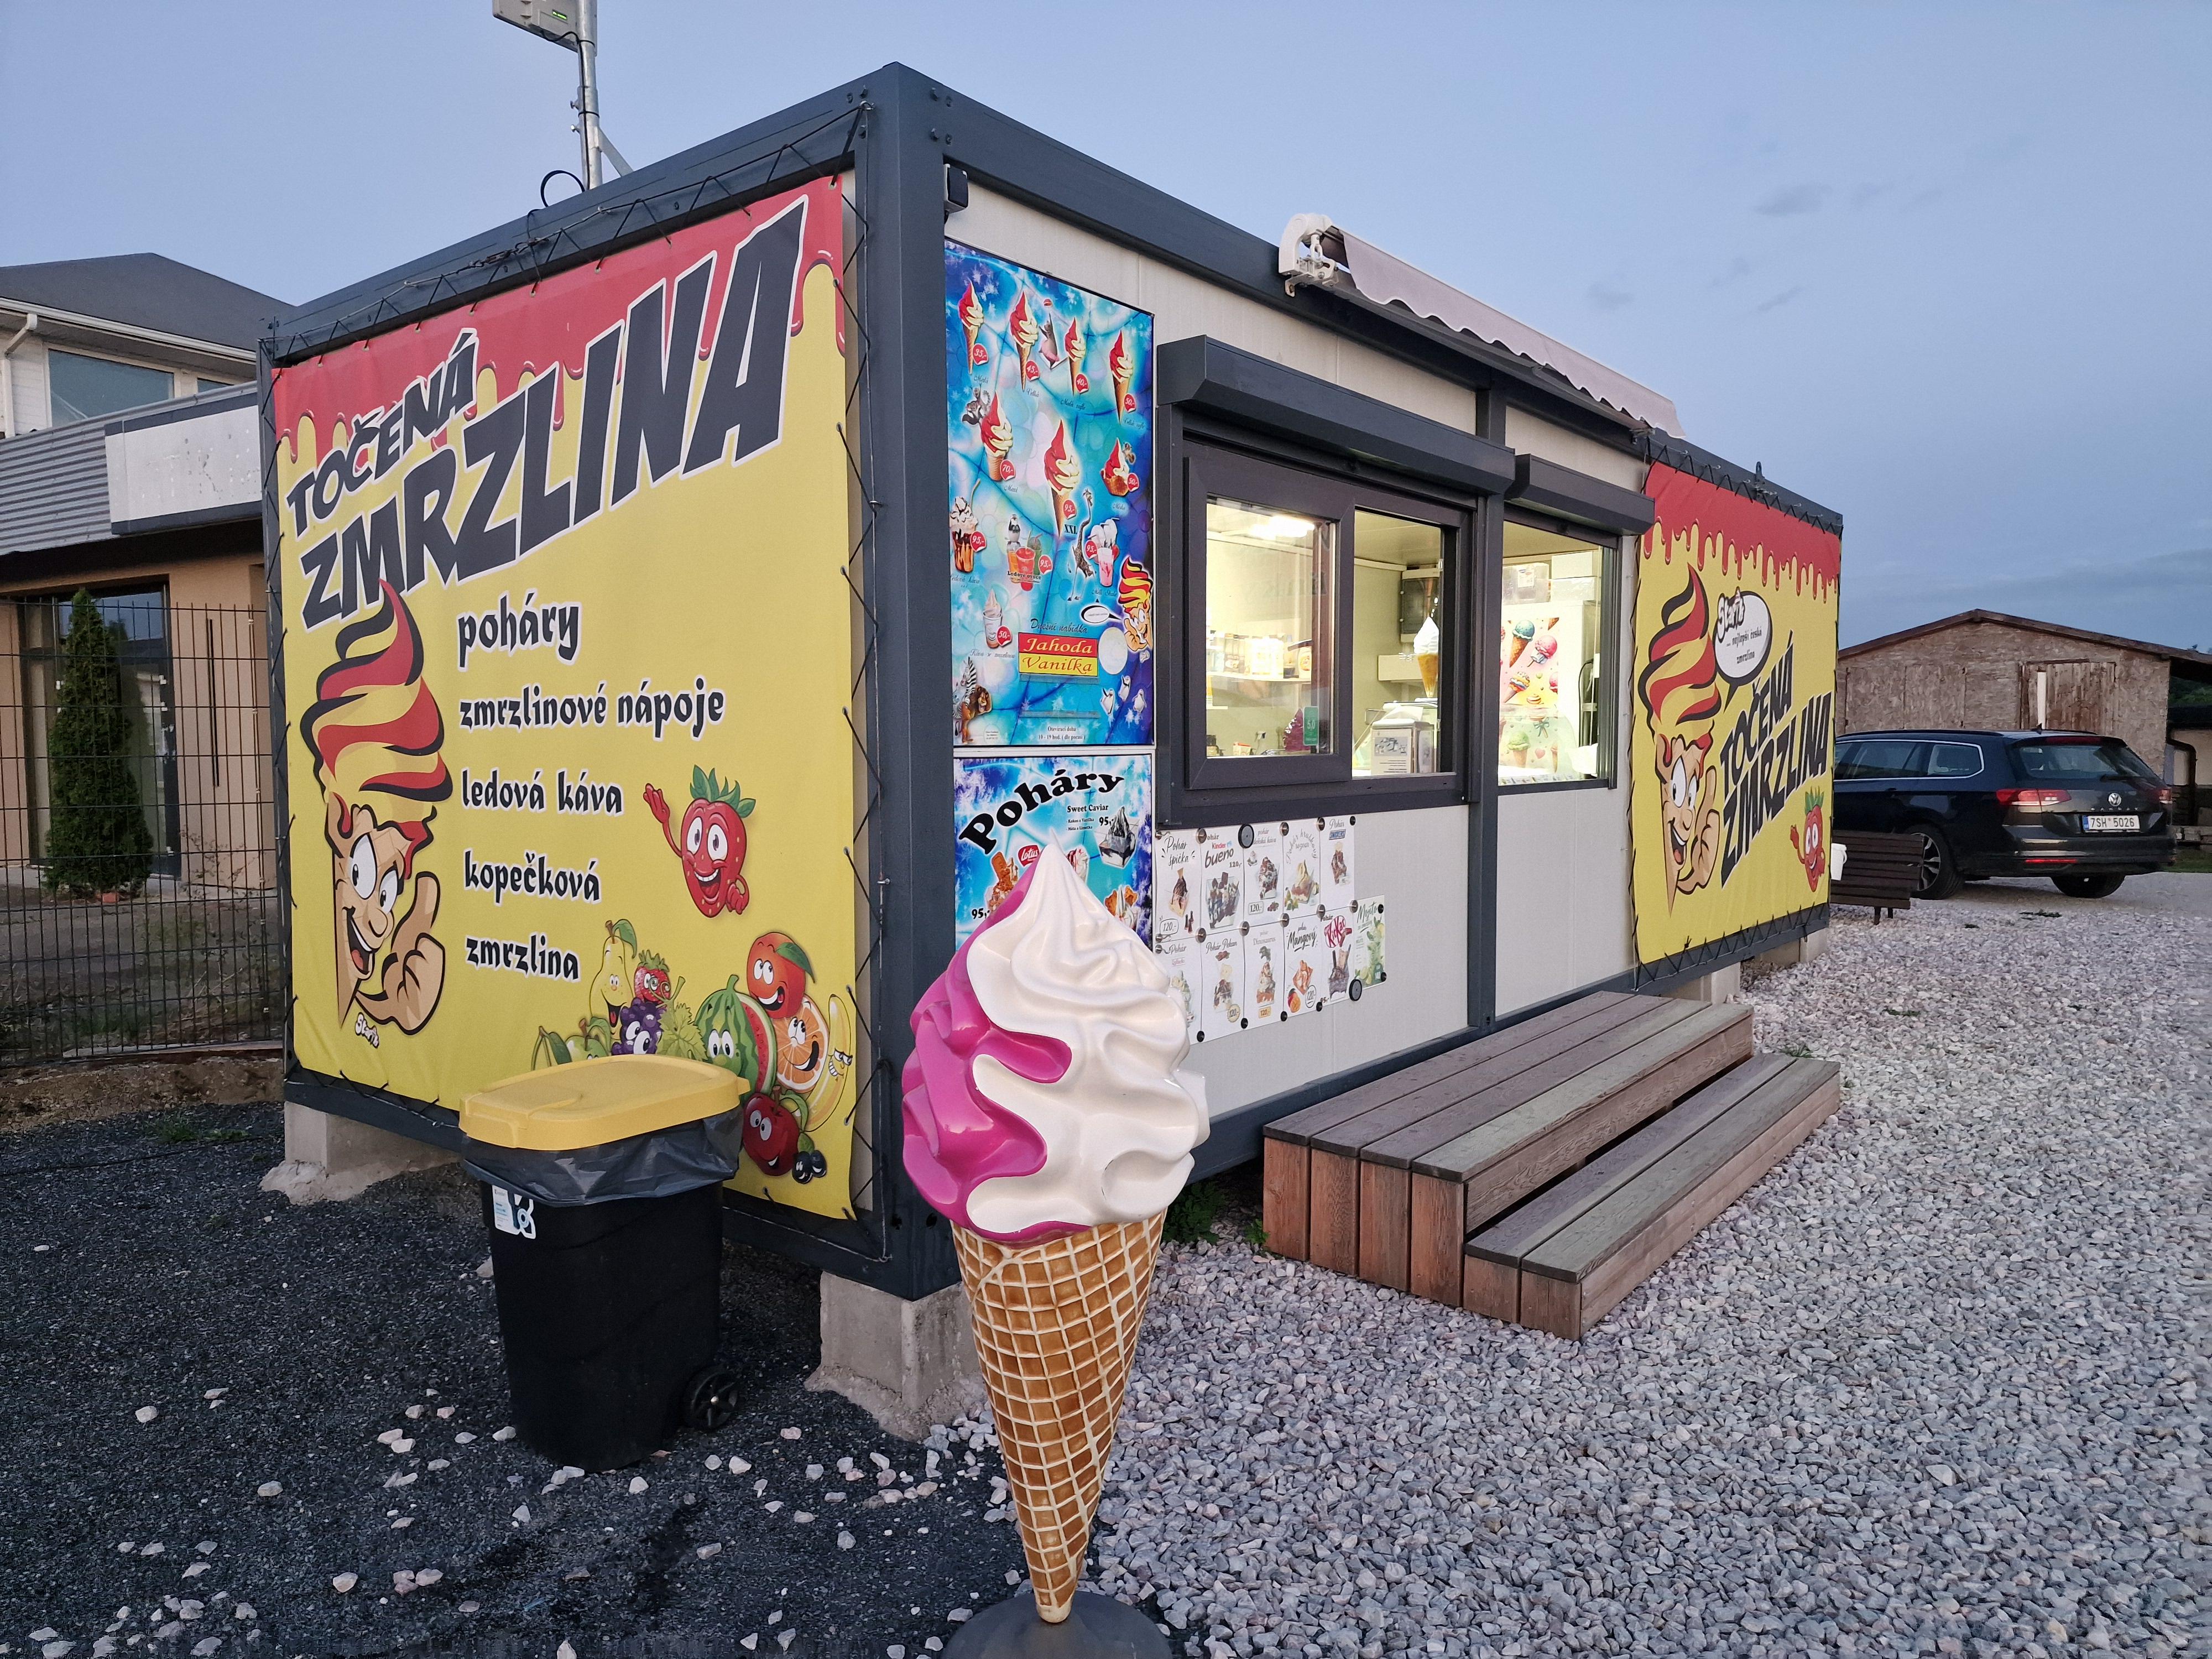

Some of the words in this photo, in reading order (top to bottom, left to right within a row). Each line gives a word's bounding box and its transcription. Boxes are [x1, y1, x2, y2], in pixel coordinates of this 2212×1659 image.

[288, 332, 477, 532] TOČENÁ
[301, 200, 804, 627] ZMRZLINA
[1065, 524, 1078, 534] XXL
[460, 593, 578, 666] poháry
[1024, 638, 1093, 654] Jahoda
[1022, 656, 1093, 674] Vanilka
[460, 682, 605, 729] zmrzlinové
[618, 678, 724, 737] nápoje
[1720, 629, 1793, 800] TOČENÁ
[462, 770, 545, 810] ledová
[558, 771, 622, 813] káva
[958, 769, 1124, 854] Poháry
[1721, 692, 1832, 888] ZMRZLINA
[2091, 818, 2106, 827] 7SH
[2114, 818, 2135, 827] 5026
[1021, 847, 1039, 860] Lotus
[1165, 836, 1187, 853] Pohár
[1205, 848, 1234, 868] bueno
[465, 852, 601, 904] kopečková
[467, 937, 579, 979] zmrzlina
